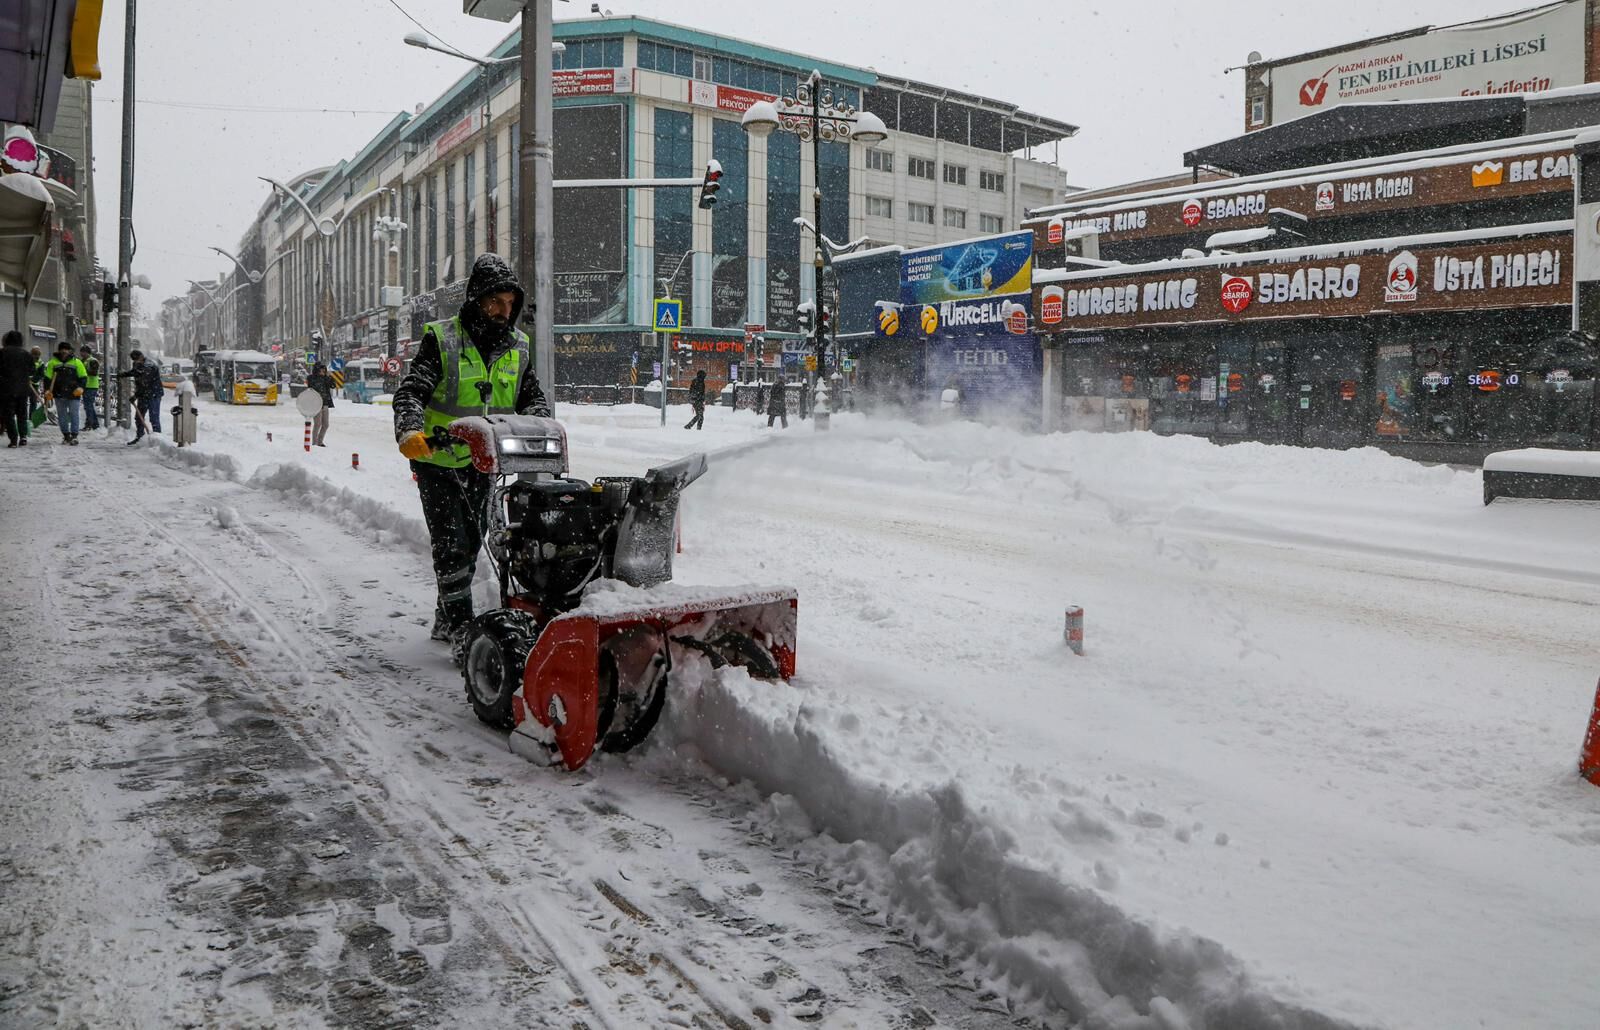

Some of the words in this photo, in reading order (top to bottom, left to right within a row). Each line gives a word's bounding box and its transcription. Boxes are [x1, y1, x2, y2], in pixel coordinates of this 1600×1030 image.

[1338, 60, 1365, 73] NAZMİ
[1368, 53, 1403, 67] ARIKAN
[1339, 72, 1371, 91] FEN
[1378, 49, 1475, 83] BİLİMLERİ
[1482, 34, 1546, 63] LİSESİ
[1339, 90, 1353, 98] Van
[1354, 82, 1387, 96] Anadolu
[1388, 81, 1397, 89] ve
[1400, 78, 1415, 87] Fen
[1417, 73, 1441, 83] Lisesi
[1344, 182, 1372, 202] USTA
[1207, 194, 1265, 219] SBARRO
[1259, 263, 1360, 303] SBARRO
[1434, 255, 1483, 291] USTA
[1067, 284, 1138, 317] BURGER
[1143, 278, 1198, 312] KING
[1222, 291, 1250, 299] SBARRO
[1043, 309, 1062, 318] KING
